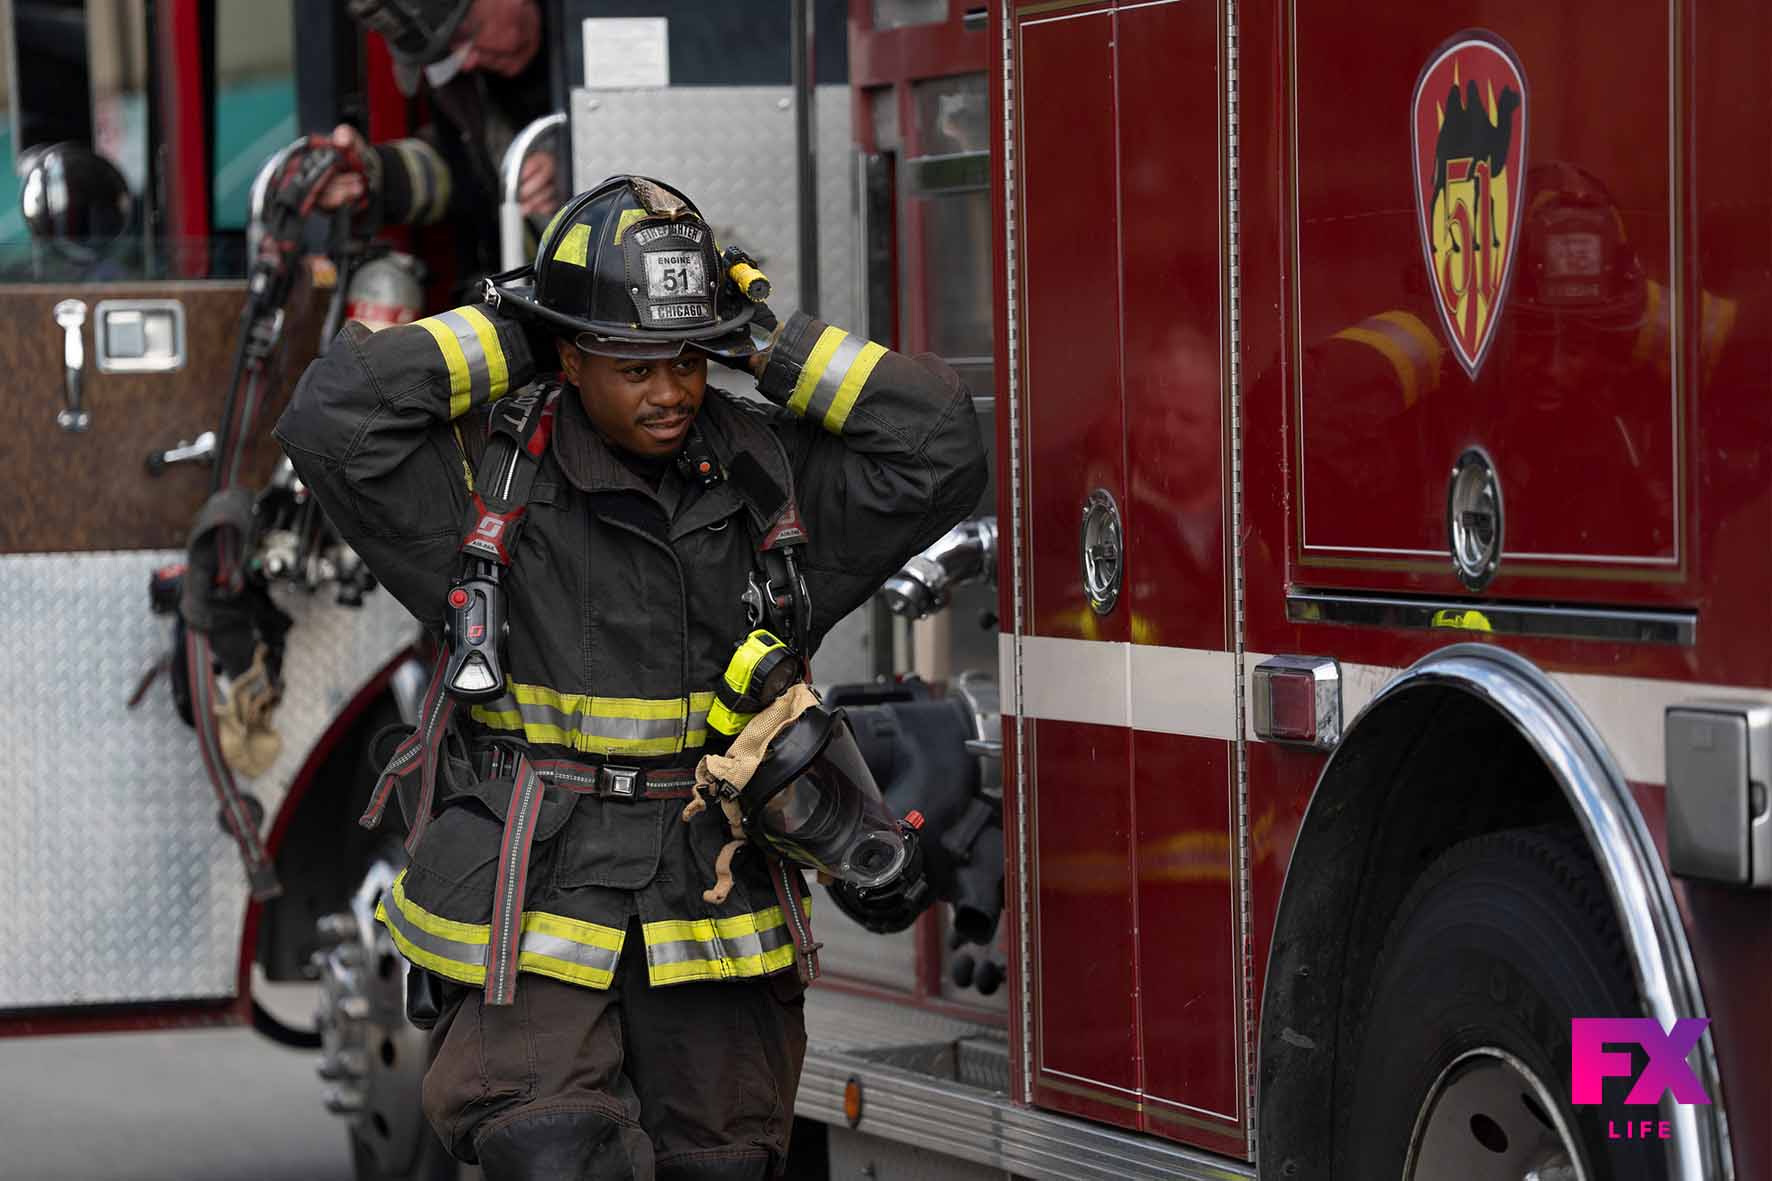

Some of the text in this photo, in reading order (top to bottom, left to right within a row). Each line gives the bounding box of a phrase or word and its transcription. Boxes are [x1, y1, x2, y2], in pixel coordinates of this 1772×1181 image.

[641, 223, 699, 243] FIREFHTER
[658, 256, 691, 265] ENGINE
[663, 268, 689, 291] 51
[658, 305, 703, 319] CHICAGO
